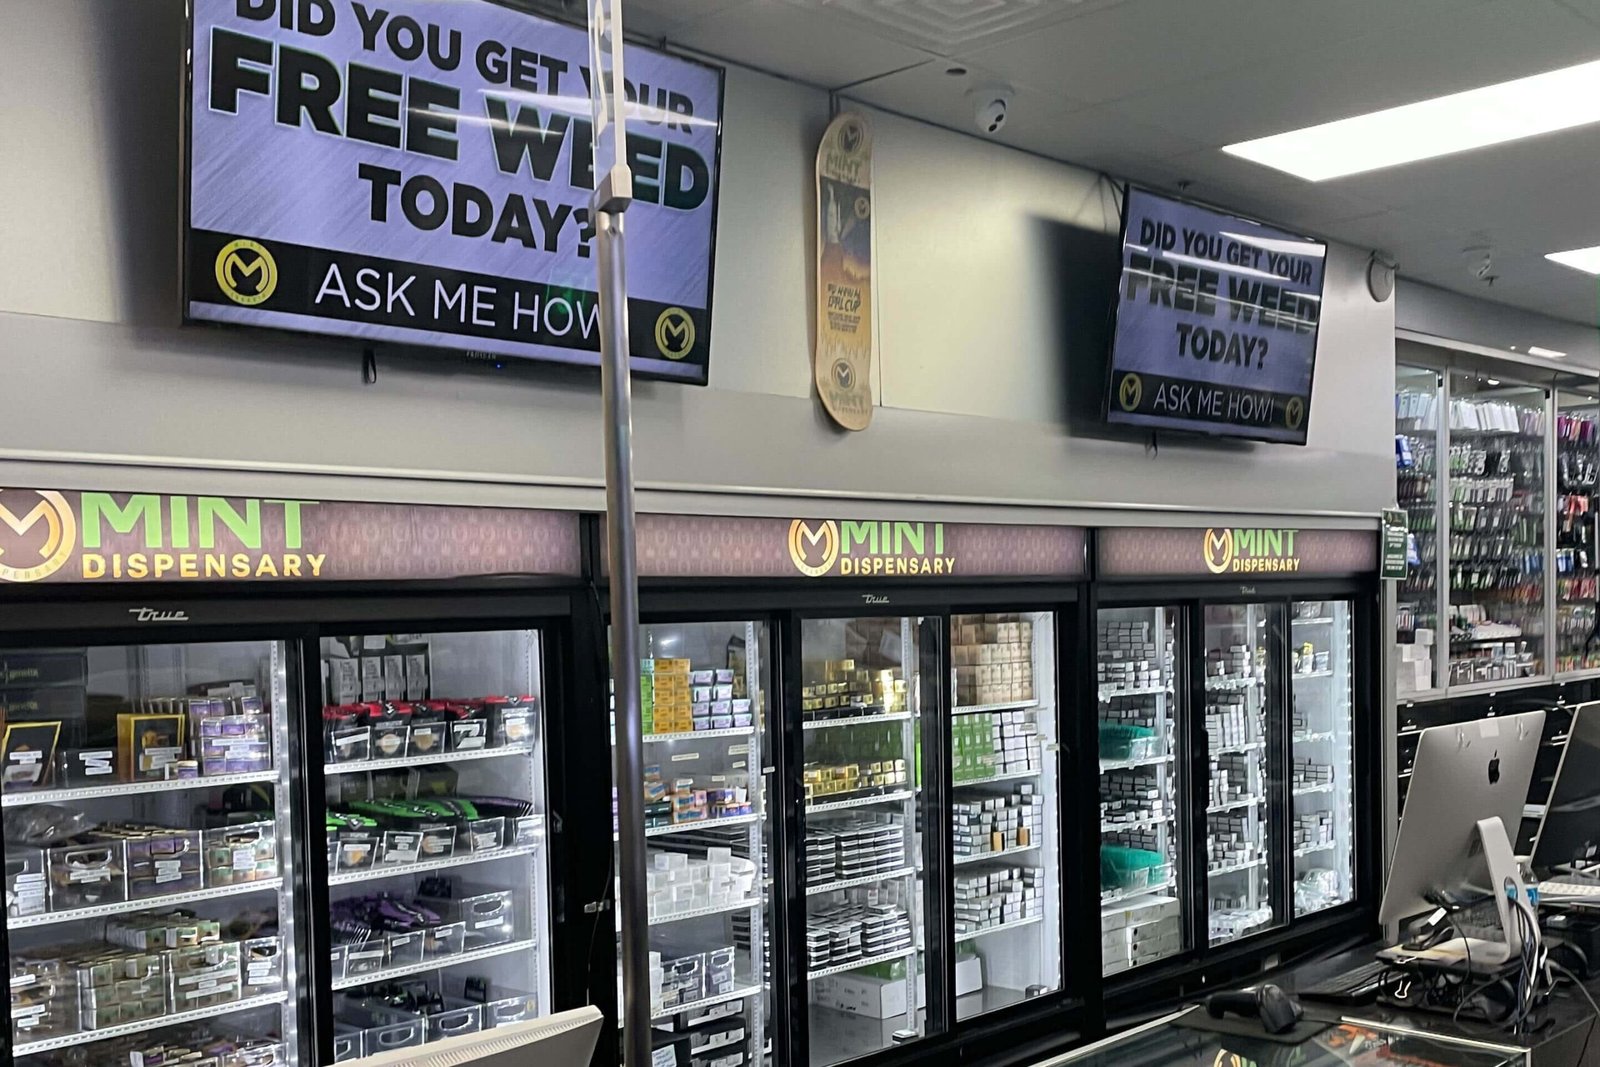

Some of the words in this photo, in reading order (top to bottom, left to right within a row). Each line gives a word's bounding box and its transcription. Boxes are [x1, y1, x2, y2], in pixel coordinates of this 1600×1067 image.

[352, 1, 462, 72] YOU
[476, 40, 568, 96] GET
[209, 26, 460, 160] FREE
[357, 163, 595, 258] TODAY?
[1140, 218, 1176, 251] DID
[1183, 227, 1223, 262] YOU
[1227, 242, 1262, 270] GET
[1268, 252, 1312, 285] YOUR
[315, 263, 416, 316] ASK
[434, 279, 497, 327] ME
[1127, 253, 1219, 317] FREE
[1228, 275, 1320, 334] WEED
[1177, 323, 1268, 370] TODAY?
[1154, 382, 1193, 413] ASK
[1197, 390, 1223, 416] ME
[1228, 391, 1274, 422] HOW!
[82, 491, 320, 549] MINT
[1233, 529, 1299, 557] MINT
[83, 553, 326, 579] DISPENSARY
[840, 557, 956, 575] DISPENSARY
[1232, 558, 1300, 573] DISPENSARY
